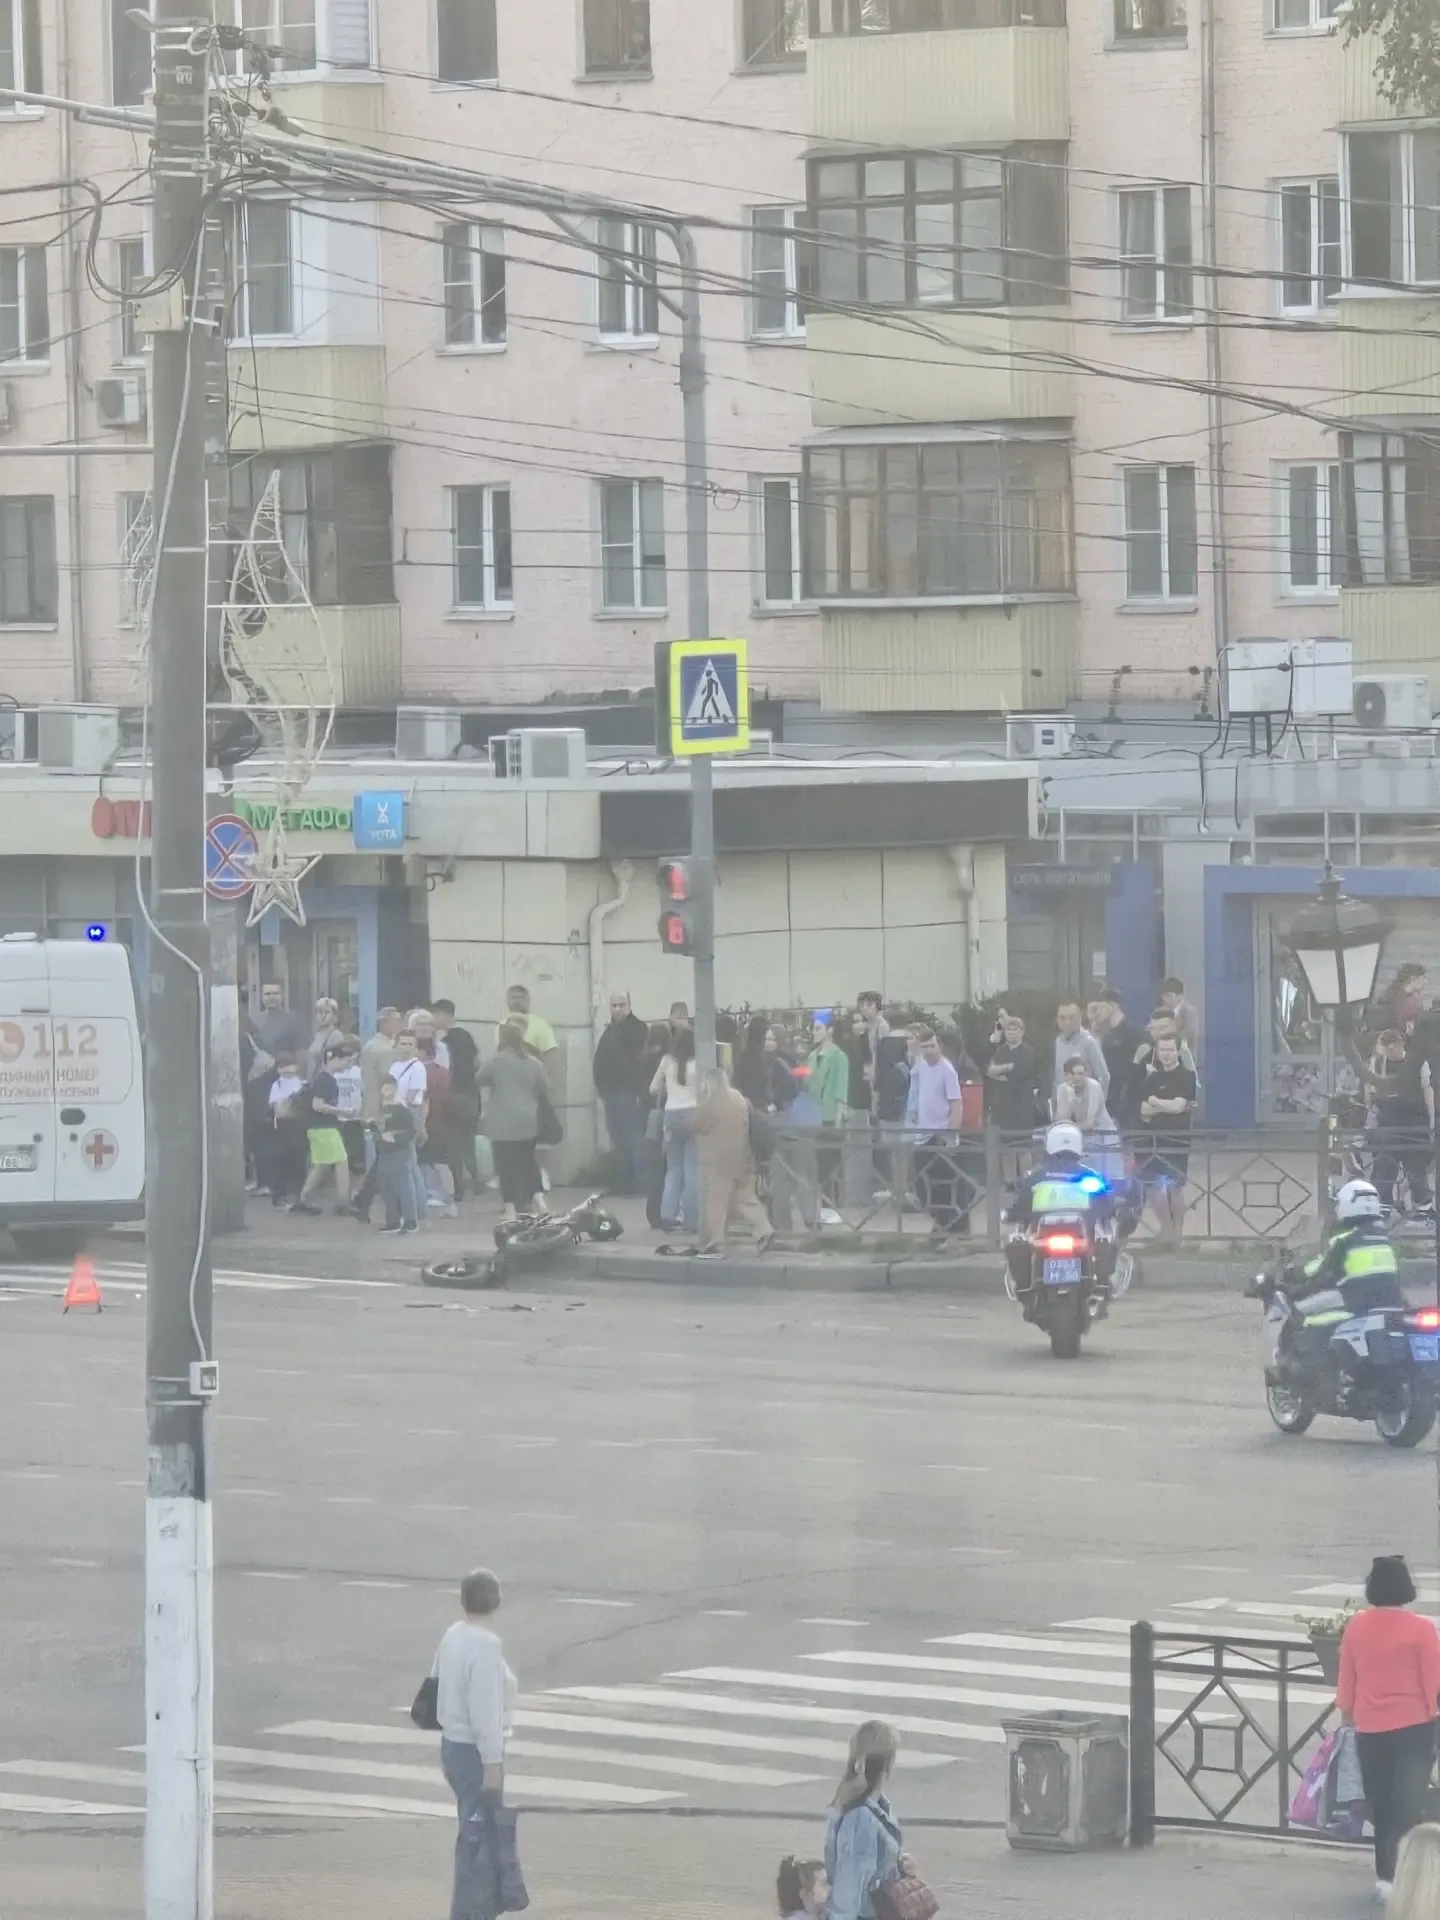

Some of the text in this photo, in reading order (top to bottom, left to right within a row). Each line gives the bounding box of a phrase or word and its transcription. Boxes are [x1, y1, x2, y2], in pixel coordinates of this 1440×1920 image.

[250, 803, 351, 831] МЕГАФО
[32, 1022, 99, 1059] 112
[56, 1067, 100, 1083] НОМЕР
[42, 1087, 100, 1098] САСЕНИЯ
